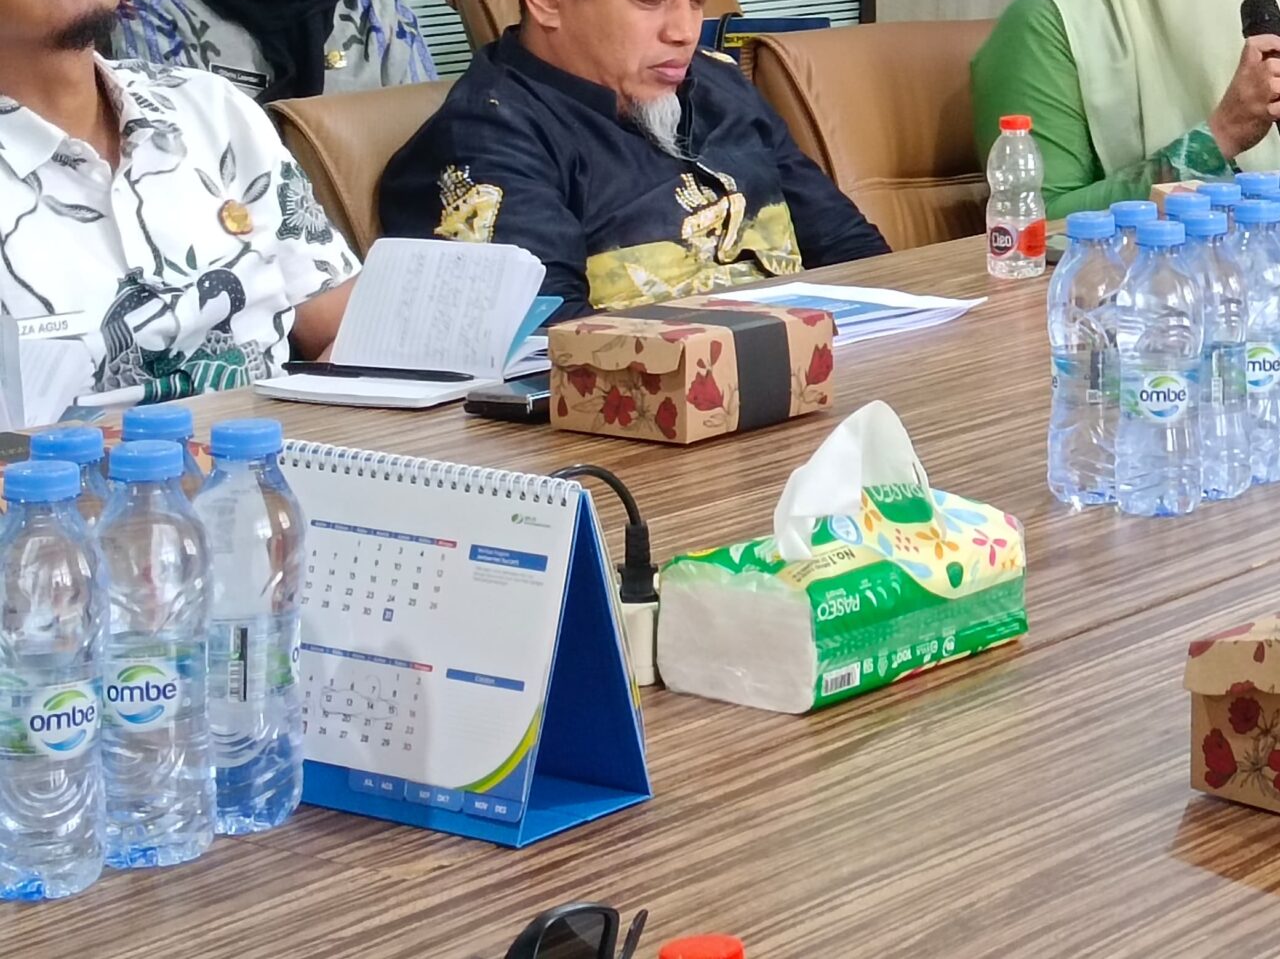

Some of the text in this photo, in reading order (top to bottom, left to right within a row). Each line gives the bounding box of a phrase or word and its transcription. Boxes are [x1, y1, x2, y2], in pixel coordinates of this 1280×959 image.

[21, 324, 35, 336] ZA
[1247, 357, 1280, 372] mbe
[1140, 388, 1187, 401] ombe
[107, 681, 177, 702] ombe
[30, 705, 95, 732] ombe
